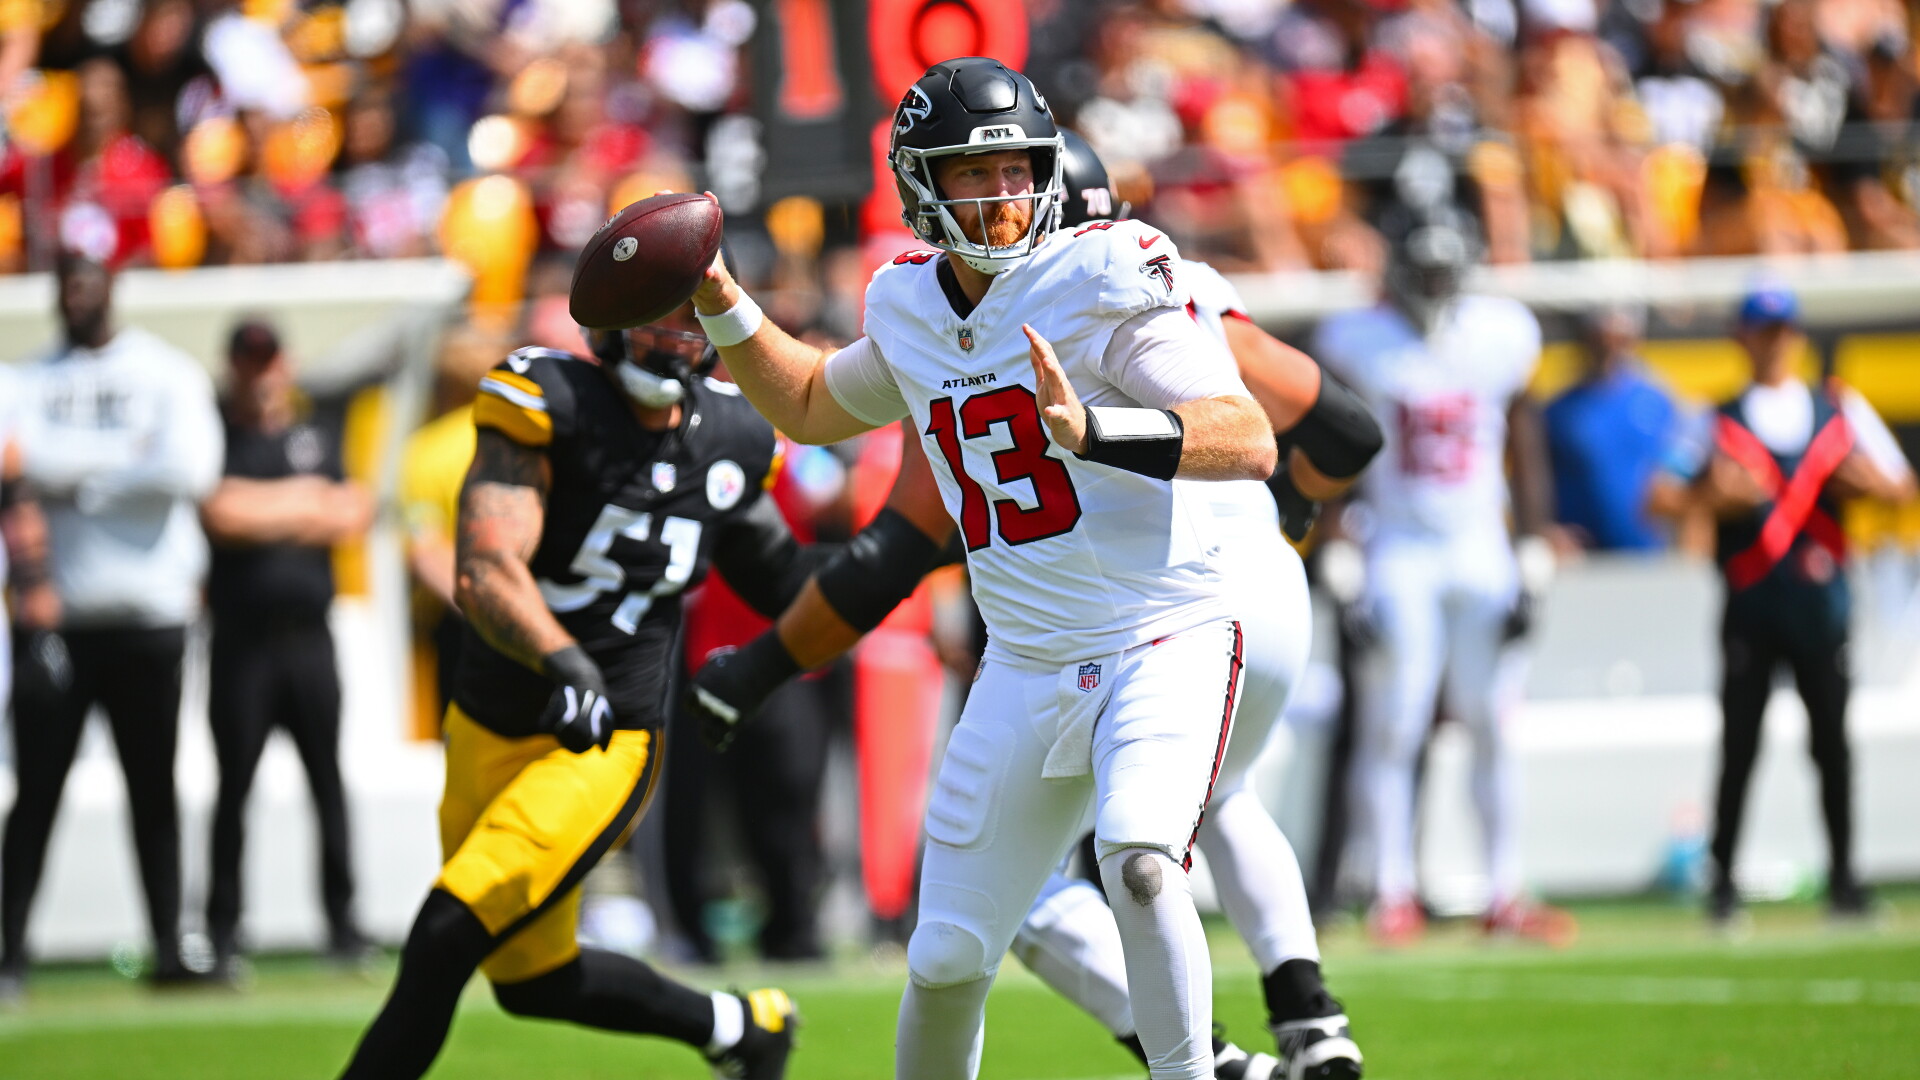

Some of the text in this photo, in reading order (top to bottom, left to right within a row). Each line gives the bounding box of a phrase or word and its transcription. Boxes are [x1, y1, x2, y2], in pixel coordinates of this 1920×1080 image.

[982, 128, 1014, 142] ATL
[1081, 187, 1112, 217] 70
[942, 372, 997, 389] ATLANTA
[925, 384, 1082, 553] 13
[1080, 675, 1098, 689] NFL
